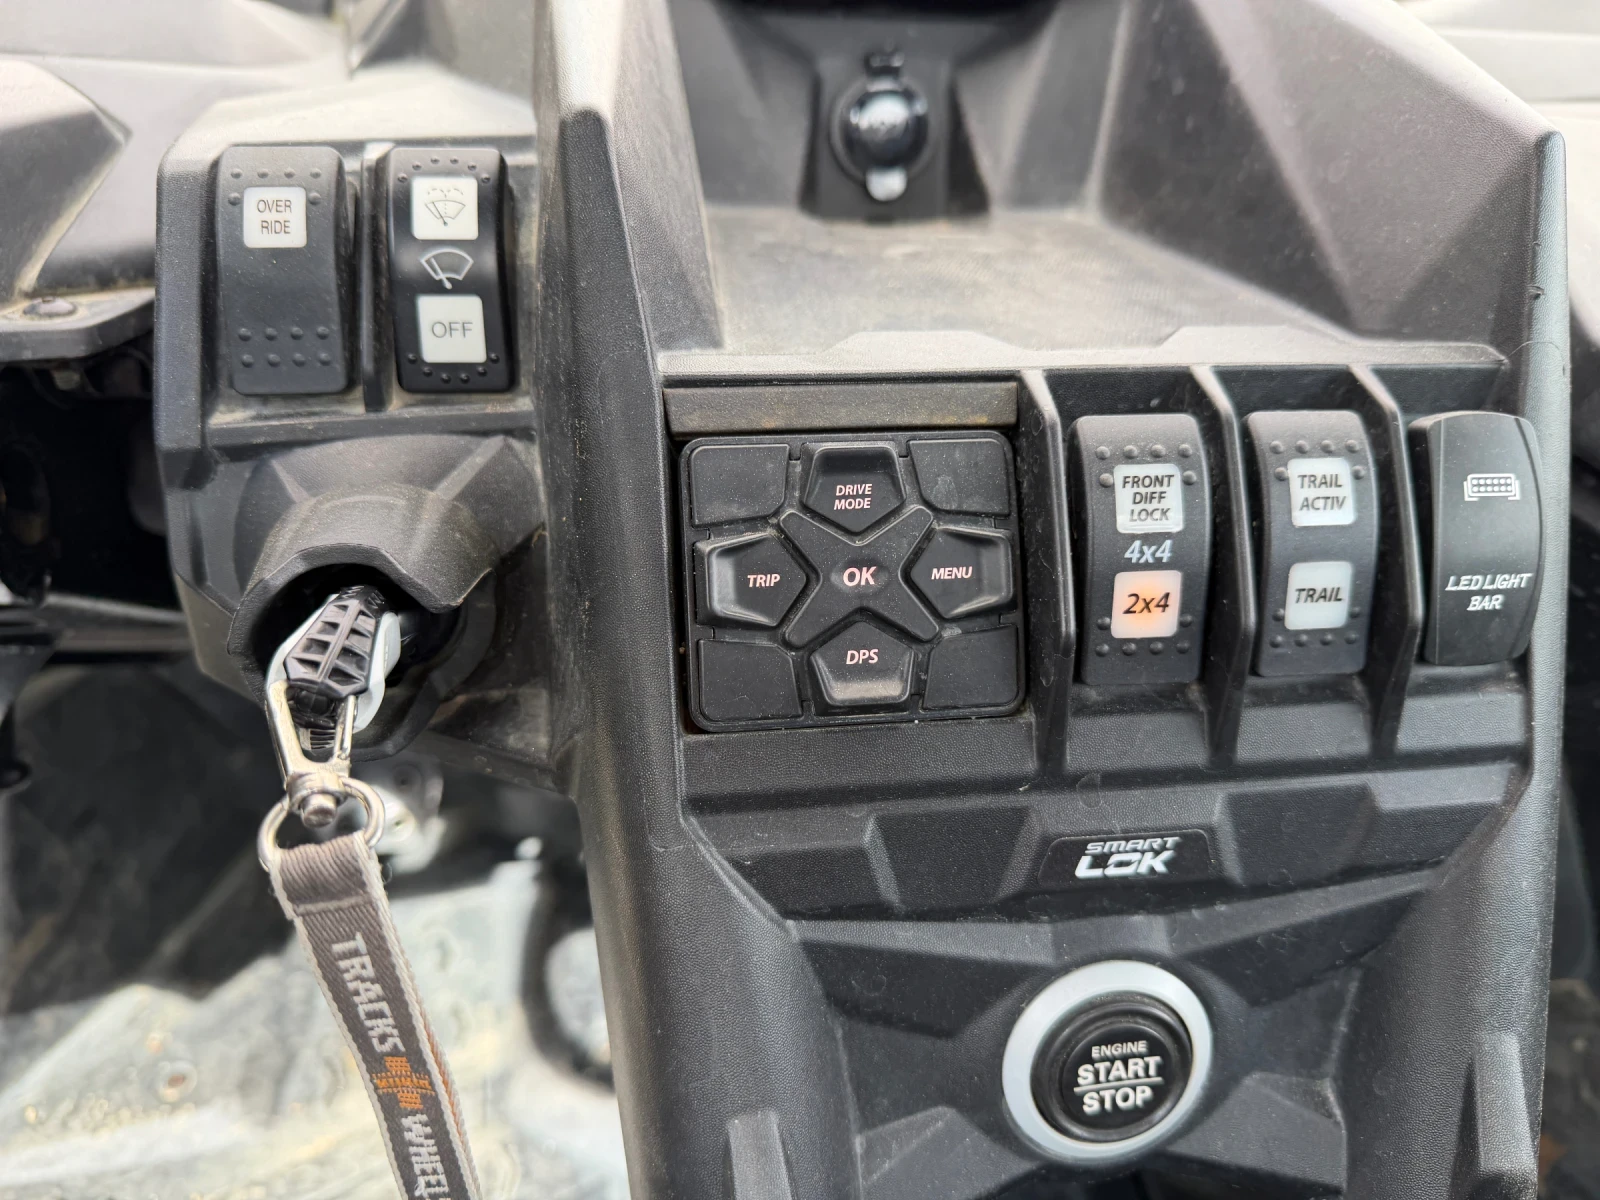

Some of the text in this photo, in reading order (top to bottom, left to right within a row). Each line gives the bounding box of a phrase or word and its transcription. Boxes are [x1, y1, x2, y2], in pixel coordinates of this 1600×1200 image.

[256, 199, 293, 214] OVER
[260, 220, 292, 235] RIDE
[431, 321, 474, 339] OFF
[835, 483, 873, 496] DRIVE
[1121, 474, 1175, 489] FRONT
[1297, 474, 1343, 489] TRAIL
[833, 497, 872, 511] MODE
[1131, 490, 1167, 505] DIFF
[1298, 496, 1347, 511] ACTIV
[1129, 507, 1171, 522] LOCK
[1123, 539, 1173, 564] 4x4
[747, 573, 781, 588] TRIP
[842, 566, 877, 587] OK
[931, 566, 973, 581] MENU
[1445, 573, 1533, 591] LED LIGHT
[1122, 592, 1171, 615] 2x4
[1295, 586, 1344, 604] TRAIL
[1466, 594, 1505, 611] BAR
[845, 648, 879, 665] DPS
[1085, 837, 1181, 854] SMART
[1075, 850, 1176, 879] LOK
[1091, 1040, 1148, 1058] ENGINE
[331, 931, 451, 1200] TRACKS WHEEL
[1077, 1055, 1163, 1086] START
[1083, 1085, 1153, 1115] STOP
